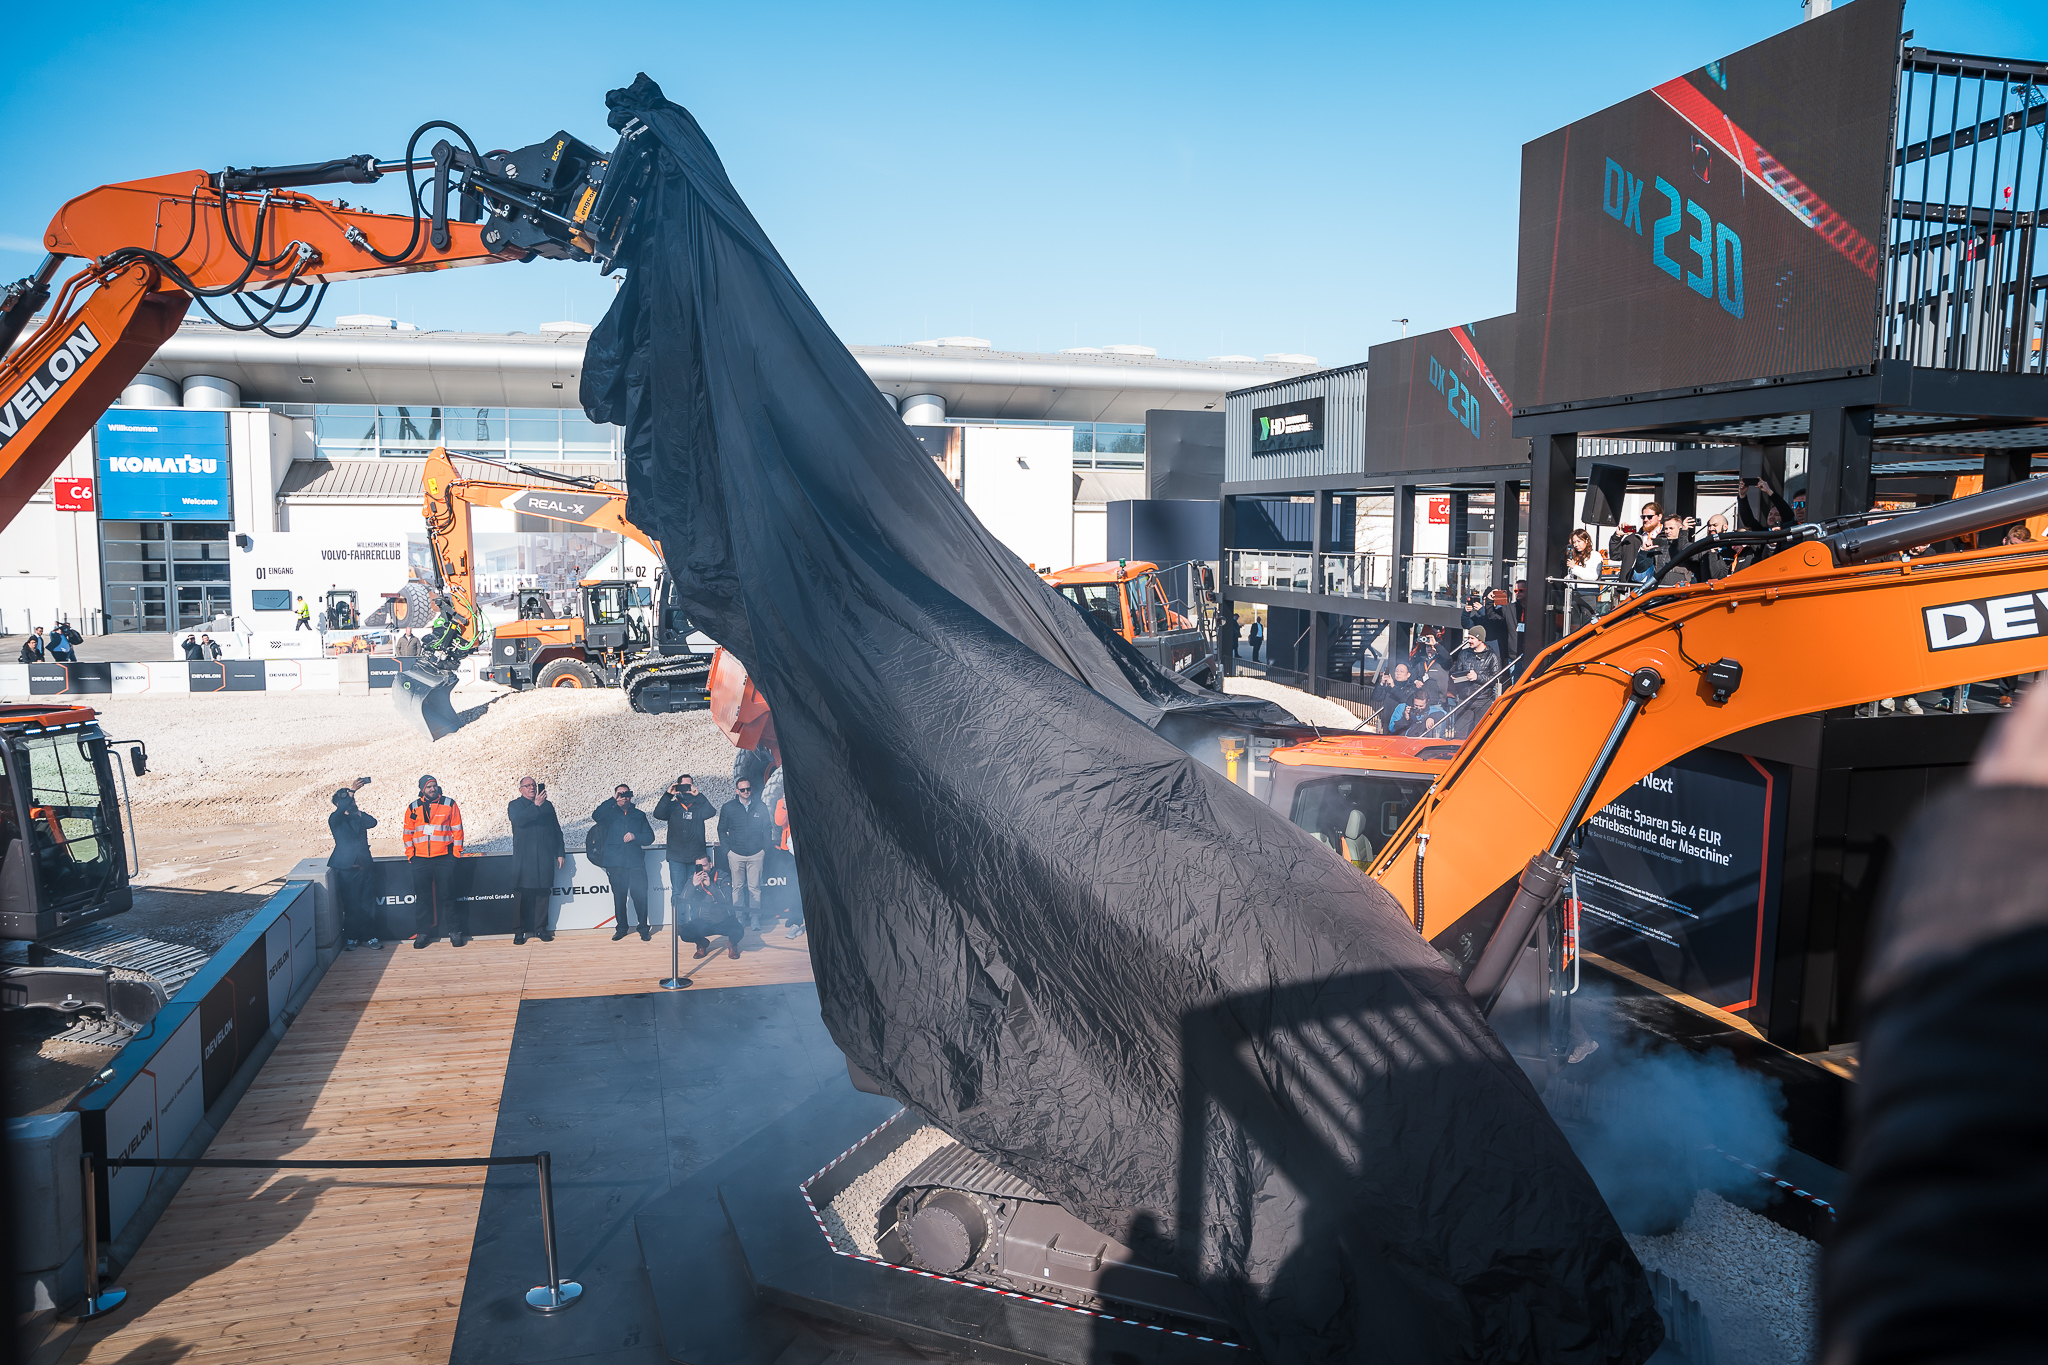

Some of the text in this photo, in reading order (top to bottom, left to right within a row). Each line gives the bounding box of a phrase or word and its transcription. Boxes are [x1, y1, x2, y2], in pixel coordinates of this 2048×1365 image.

[1603, 156, 1745, 319] DX 230
[0, 323, 100, 448] VELON
[1429, 354, 1480, 440] DX 230
[108, 424, 158, 433] Willkommen
[1270, 417, 1286, 436] HD
[109, 454, 217, 474] KOMATSU
[70, 486, 92, 499] C6
[182, 497, 218, 506] Welcome
[528, 497, 585, 515] REAL-X
[321, 550, 401, 560] VOLVO-FAHRERCLUB
[256, 567, 294, 580] 01 EINGANG
[611, 565, 646, 577] EINNG 02
[503, 574, 538, 593] BEST
[1926, 593, 2048, 649] DE
[1642, 772, 1674, 794] Next
[1600, 803, 1722, 847] tivität: Sparen Sie 4 EUR
[1659, 834, 1677, 850] der
[376, 894, 417, 906] VELO
[268, 949, 290, 981] DEVELON
[204, 1017, 233, 1060] DEVELON
